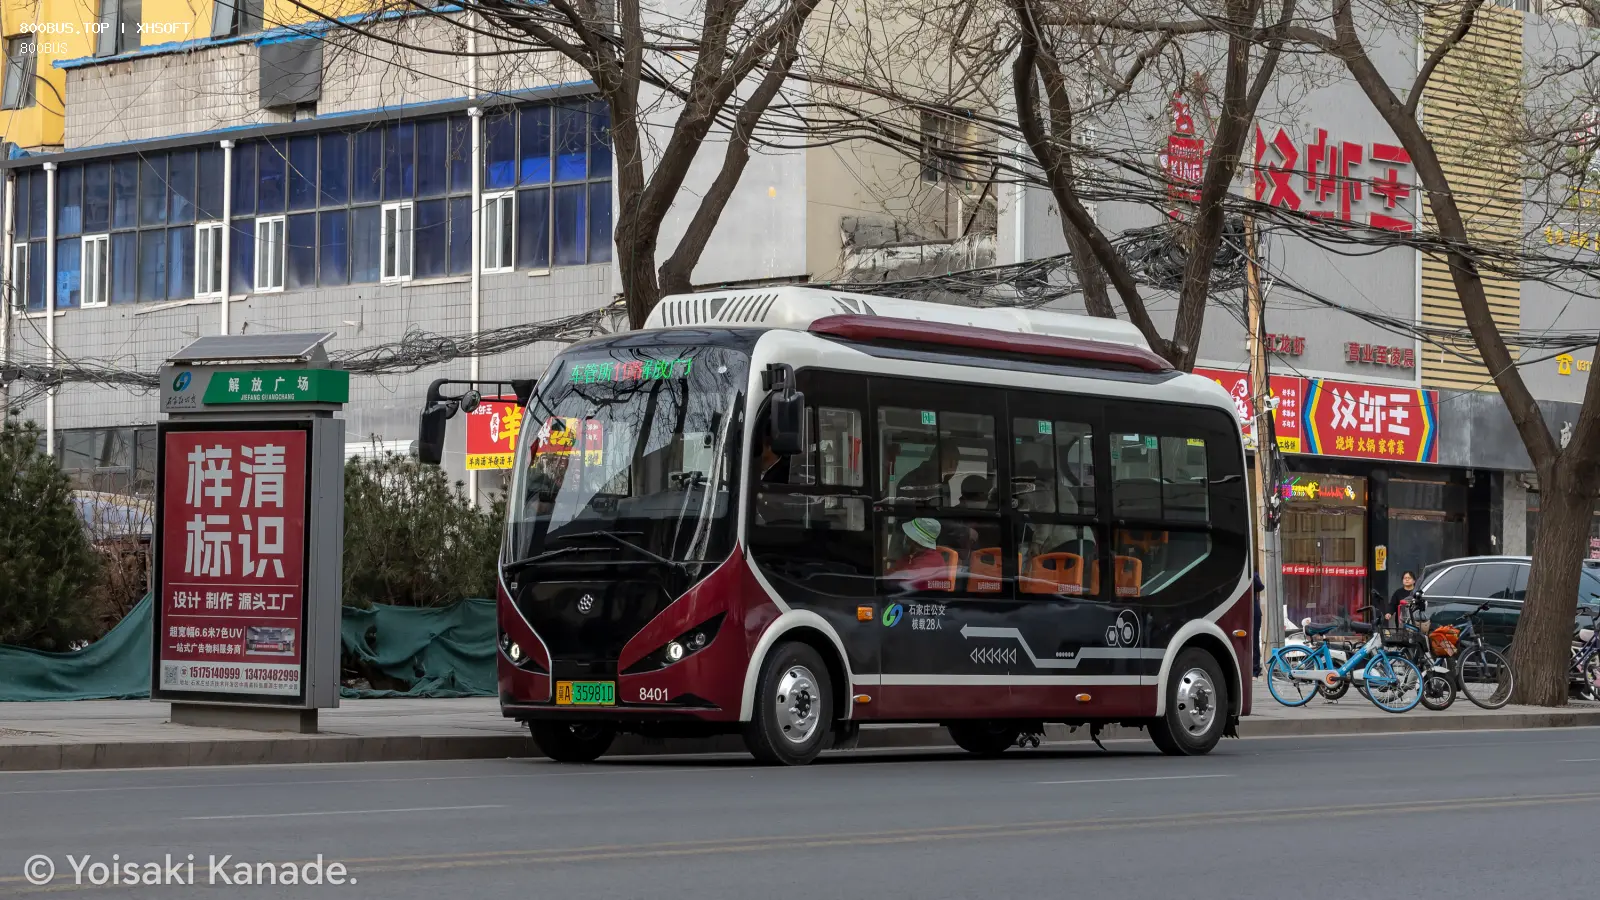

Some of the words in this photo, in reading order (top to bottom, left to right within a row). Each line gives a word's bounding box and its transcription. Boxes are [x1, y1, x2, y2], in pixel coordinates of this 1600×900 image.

[1171, 160, 1201, 182] KING
[1348, 341, 1415, 369] 营业至凌晨
[228, 375, 309, 393] 解放广场
[240, 393, 261, 401] JIEFANG
[261, 393, 295, 401] GUANGCHANG
[1335, 435, 1355, 452] 烧烤
[1357, 436, 1376, 453] 火锅
[1378, 438, 1405, 455] 家常菜
[185, 443, 287, 508] 梓清
[184, 513, 286, 579] 标识
[172, 591, 202, 610] 设计
[205, 591, 234, 610] 制作
[238, 592, 294, 611] 源头工厂
[908, 604, 946, 616] 石家庄公交
[169, 626, 243, 639] 超宽幅6.6米7色UV
[911, 617, 942, 631] 核载28人
[169, 643, 242, 655] 一站式广告物料服务商
[639, 686, 669, 701] 8401
